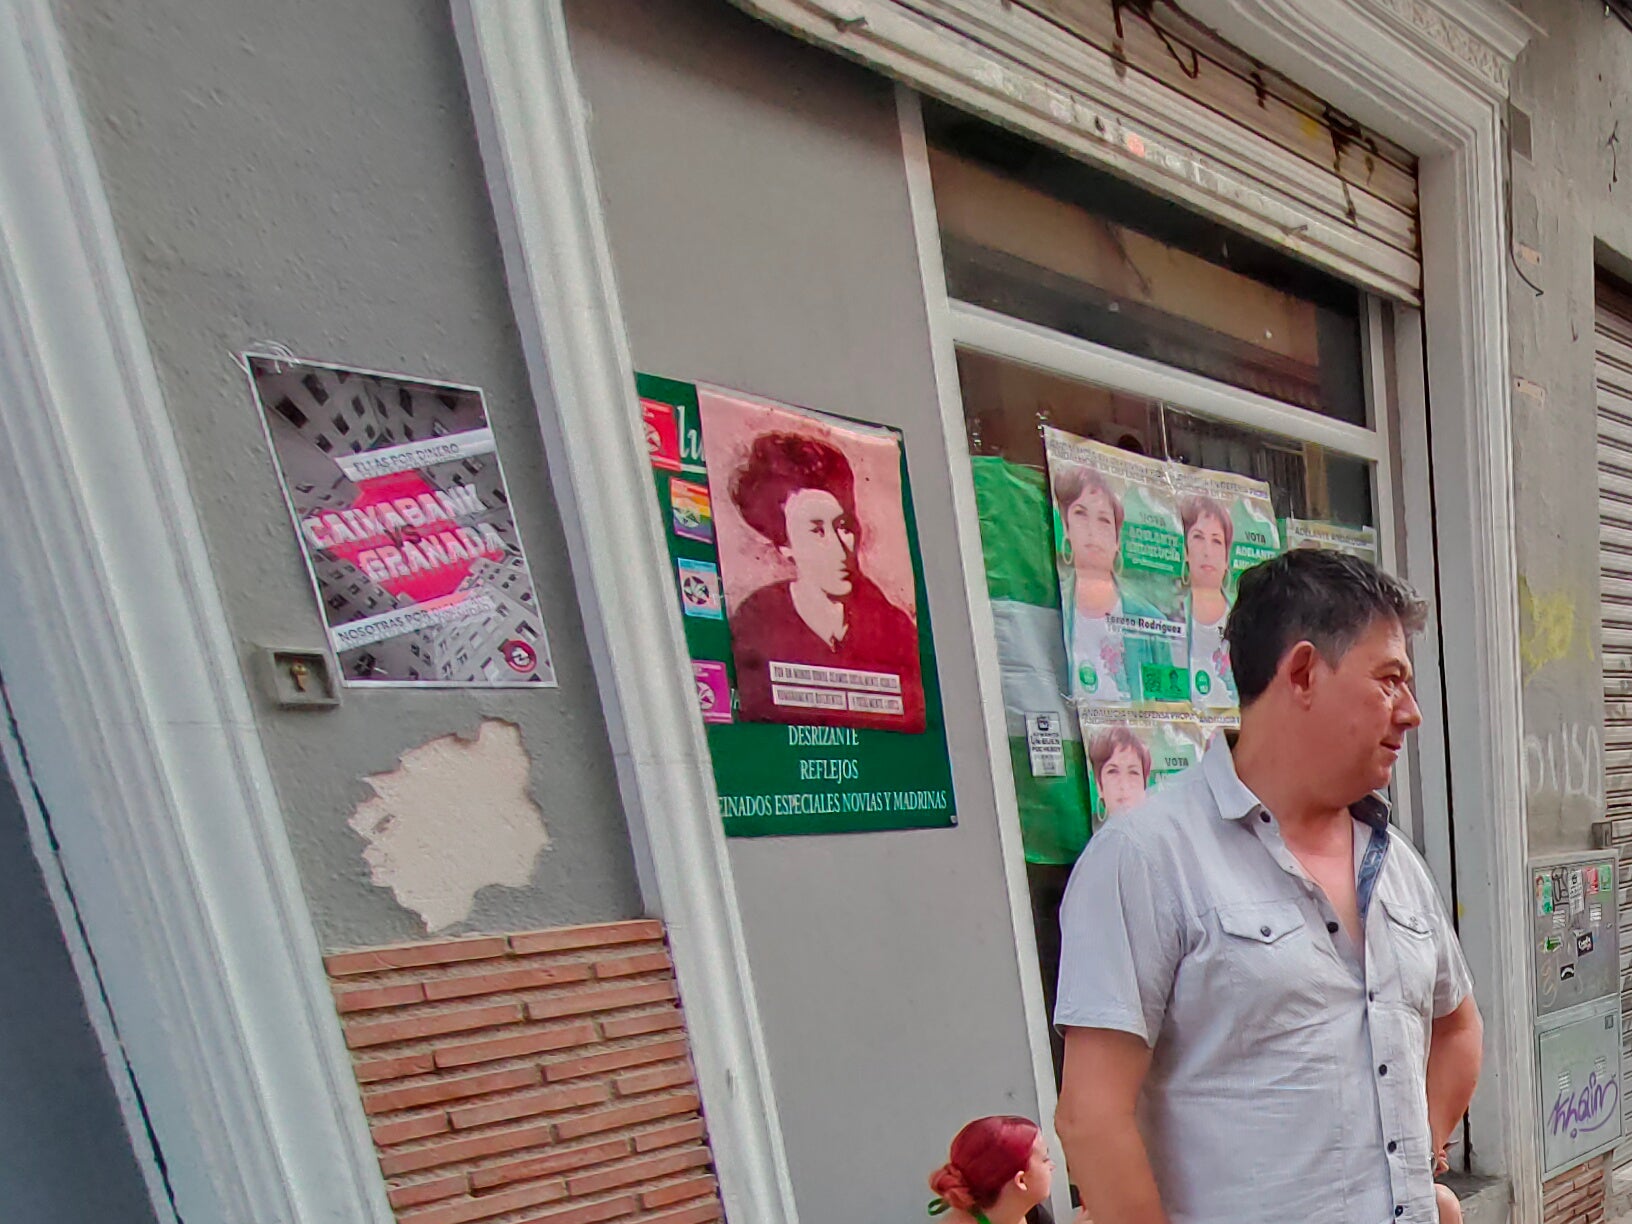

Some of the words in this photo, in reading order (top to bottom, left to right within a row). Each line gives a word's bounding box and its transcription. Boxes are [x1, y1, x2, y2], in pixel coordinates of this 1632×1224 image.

[415, 443, 460, 461] DINERO
[1245, 531, 1266, 545] VOTA
[358, 523, 508, 584] GRANADA
[338, 617, 403, 642] NOSOTRAS
[406, 609, 431, 625] POR
[788, 725, 860, 746] DESRIZANTE
[800, 759, 859, 784] REFLEJOS
[1165, 757, 1189, 767] VOTA
[774, 792, 840, 816] ESPECIALES
[842, 792, 883, 813] NOVIAS
[884, 791, 892, 812] Y
[893, 790, 947, 811] MADRINAS
